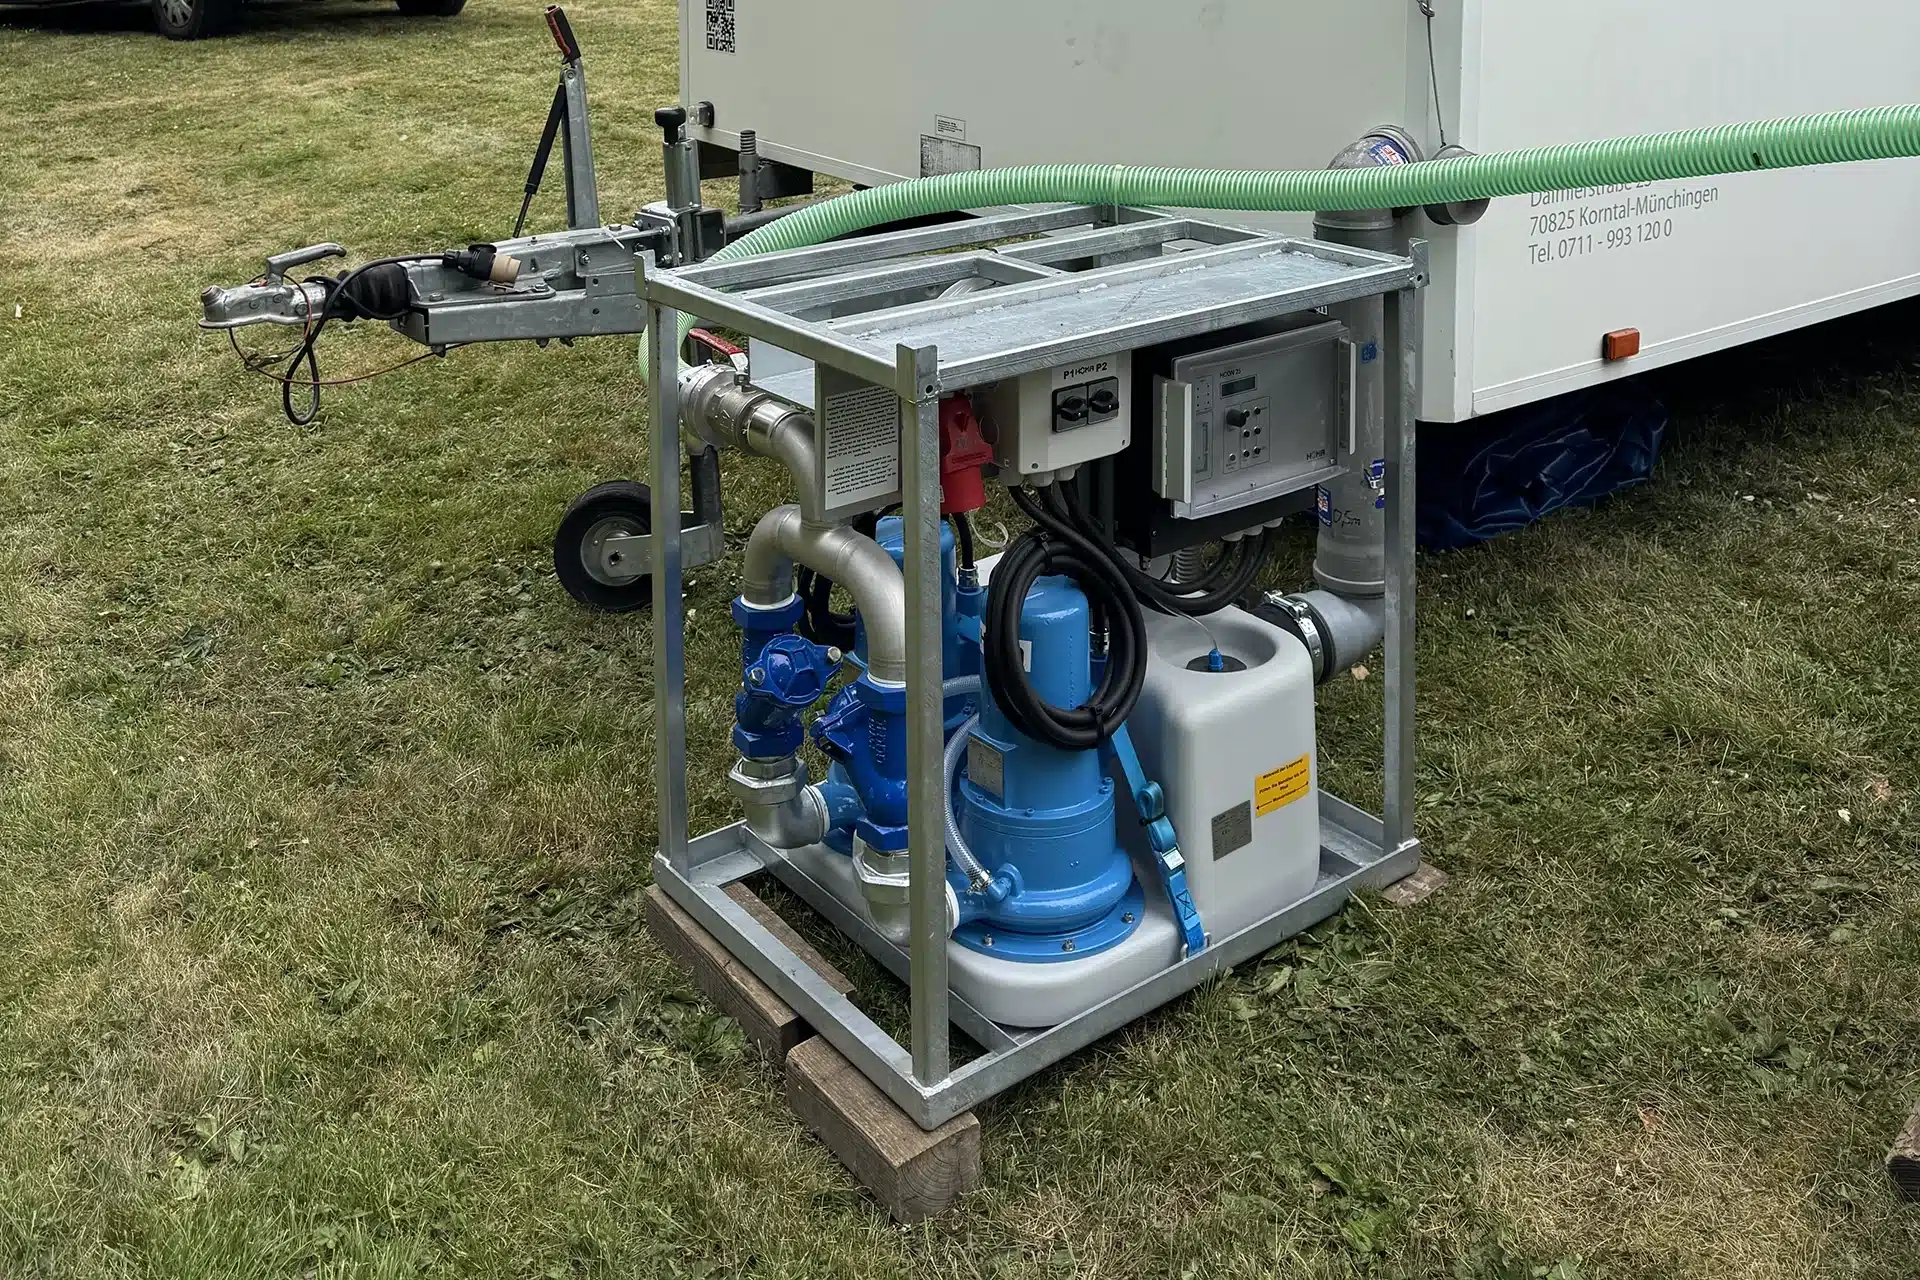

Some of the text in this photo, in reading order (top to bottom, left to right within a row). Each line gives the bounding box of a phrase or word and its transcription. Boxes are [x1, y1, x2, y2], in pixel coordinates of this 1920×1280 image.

[1530, 187, 1719, 236] 70825 Korntal-Münchingen
[1528, 240, 1554, 264] Tel.
[1558, 234, 1592, 259] 0711
[1606, 226, 1632, 249] 993
[1637, 220, 1661, 243] 120
[1663, 218, 1672, 237] 0
[1063, 370, 1075, 379] P1
[1096, 362, 1108, 372] P2
